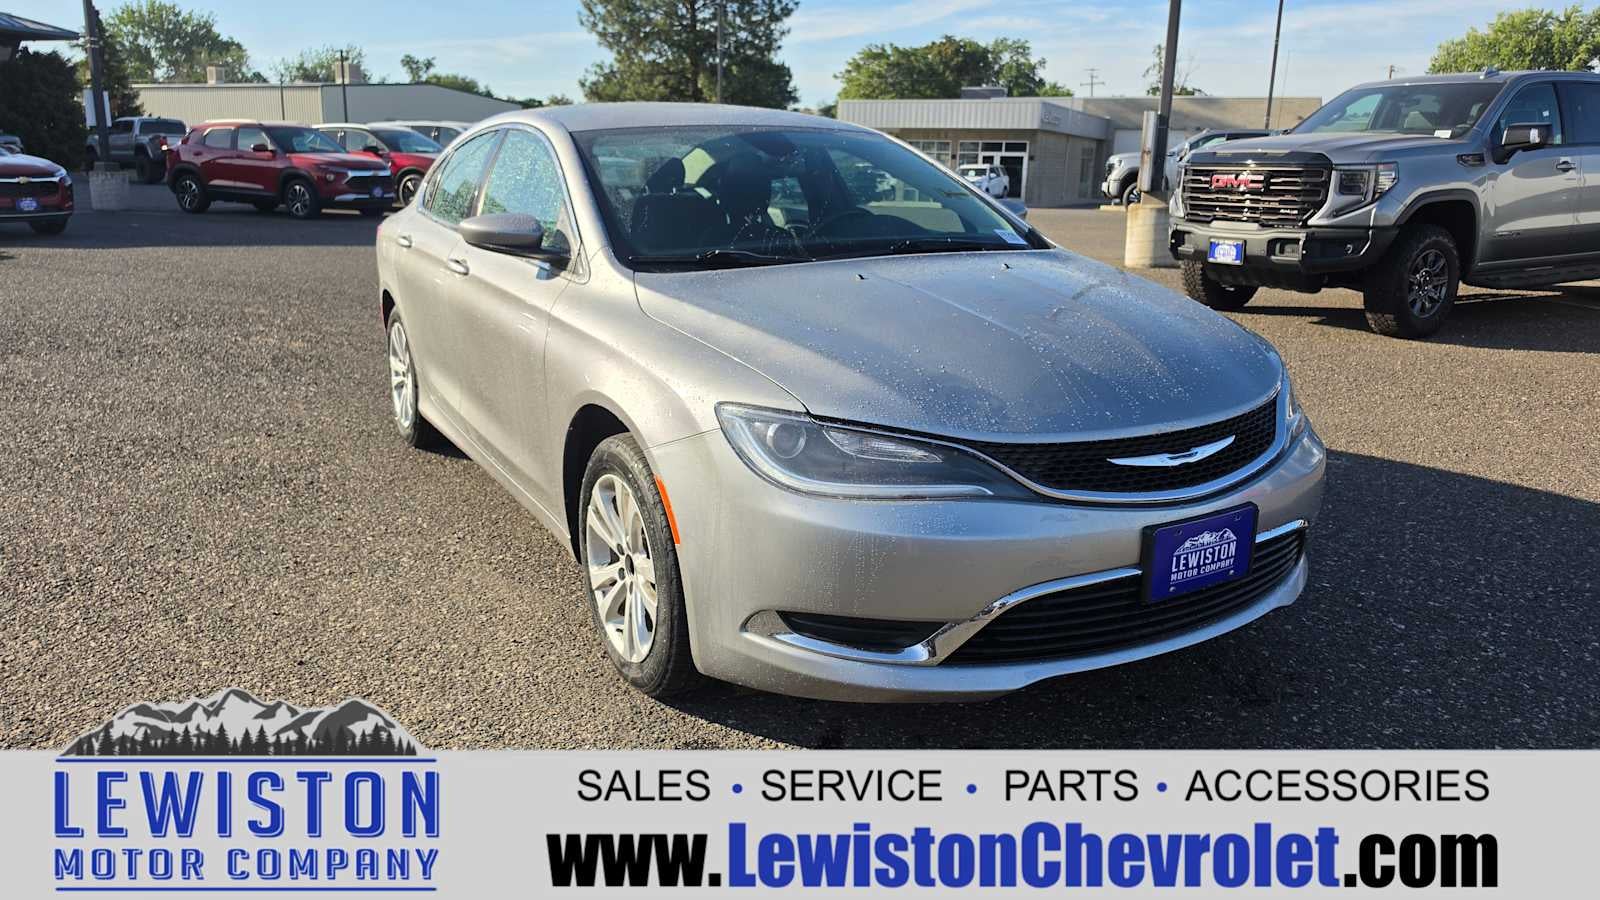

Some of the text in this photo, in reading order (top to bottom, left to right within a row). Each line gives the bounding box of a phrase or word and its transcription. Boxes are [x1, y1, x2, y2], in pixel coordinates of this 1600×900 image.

[1211, 174, 1264, 190] GMC
[1171, 541, 1236, 572] LEWISTON
[1170, 558, 1235, 582] MOTOR COMPANY
